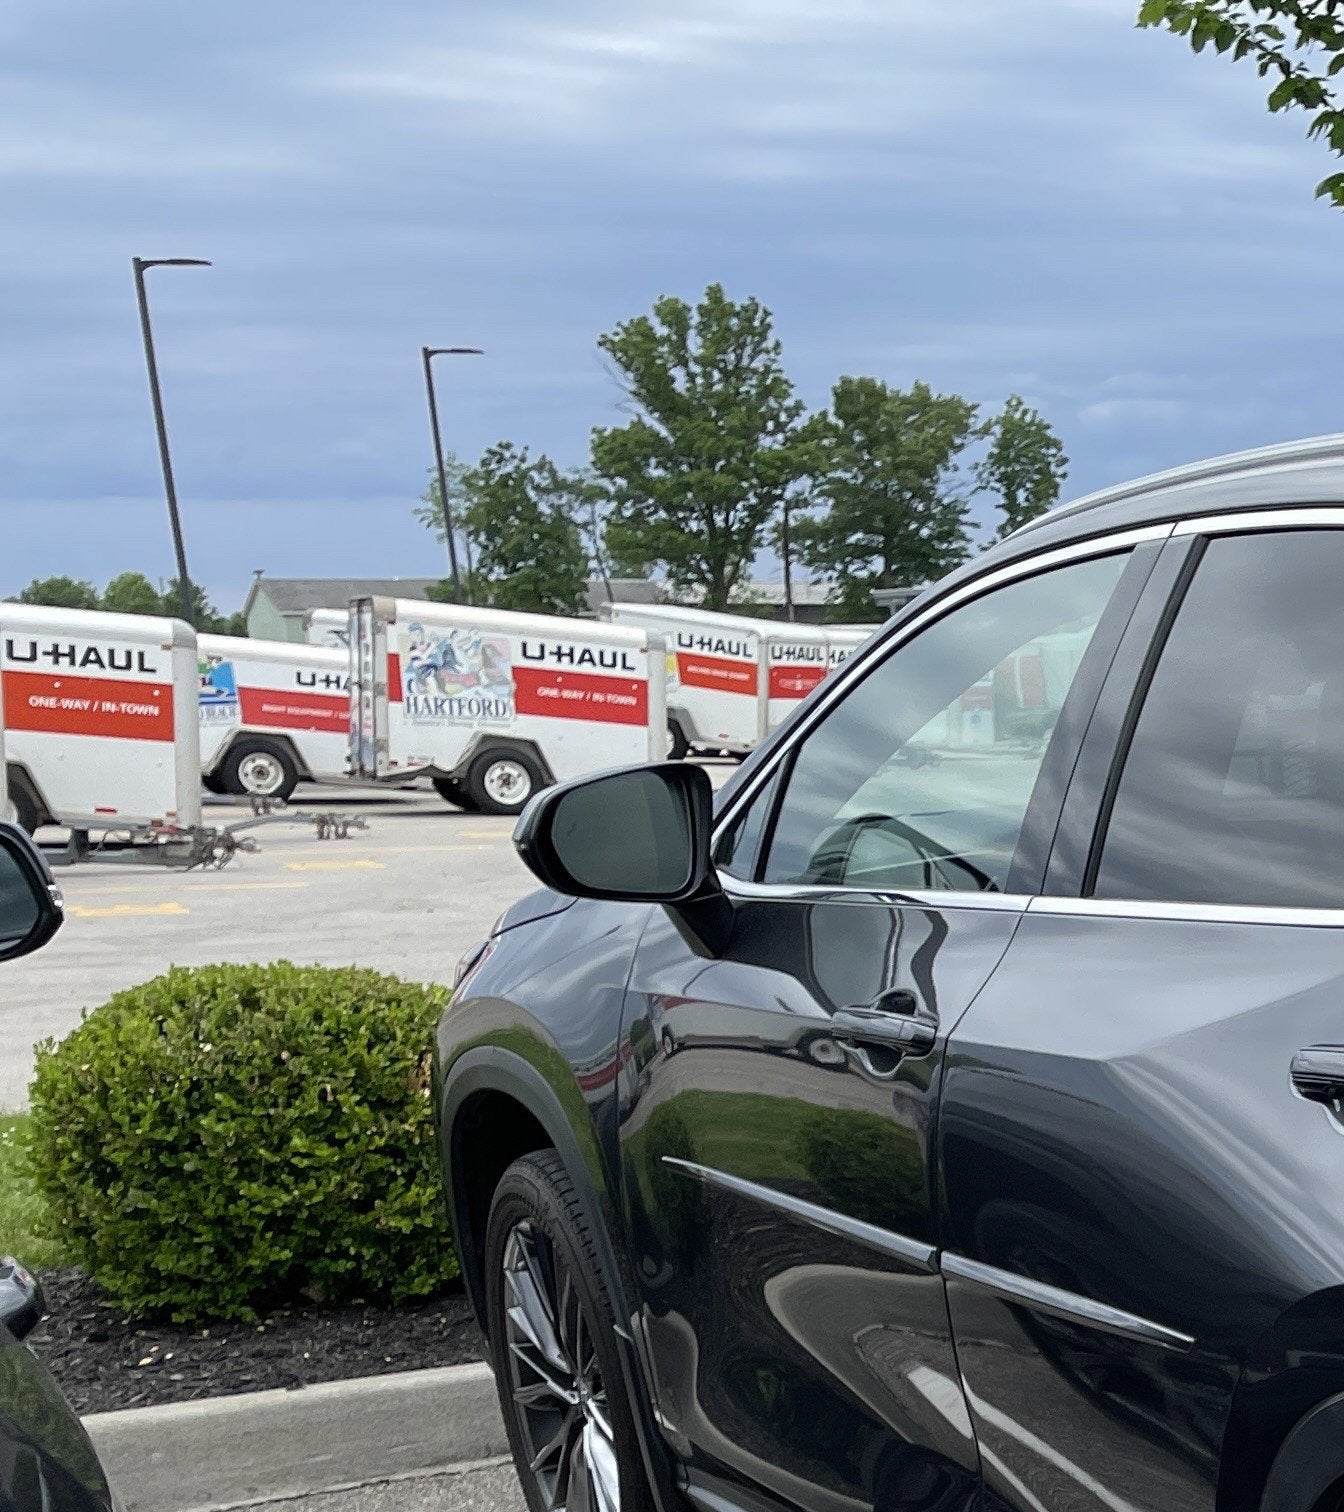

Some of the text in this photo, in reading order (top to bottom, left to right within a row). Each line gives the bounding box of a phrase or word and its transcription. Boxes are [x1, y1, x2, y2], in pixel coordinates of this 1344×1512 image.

[5, 638, 157, 674] U-HAUL
[521, 641, 637, 672] U-HAUL
[677, 632, 753, 658] U-HAUL
[770, 644, 825, 662] U-HAUL
[28, 695, 90, 712] ONE-WAY
[101, 702, 160, 717] IN-TOWN
[406, 695, 508, 718] HARTFORD
